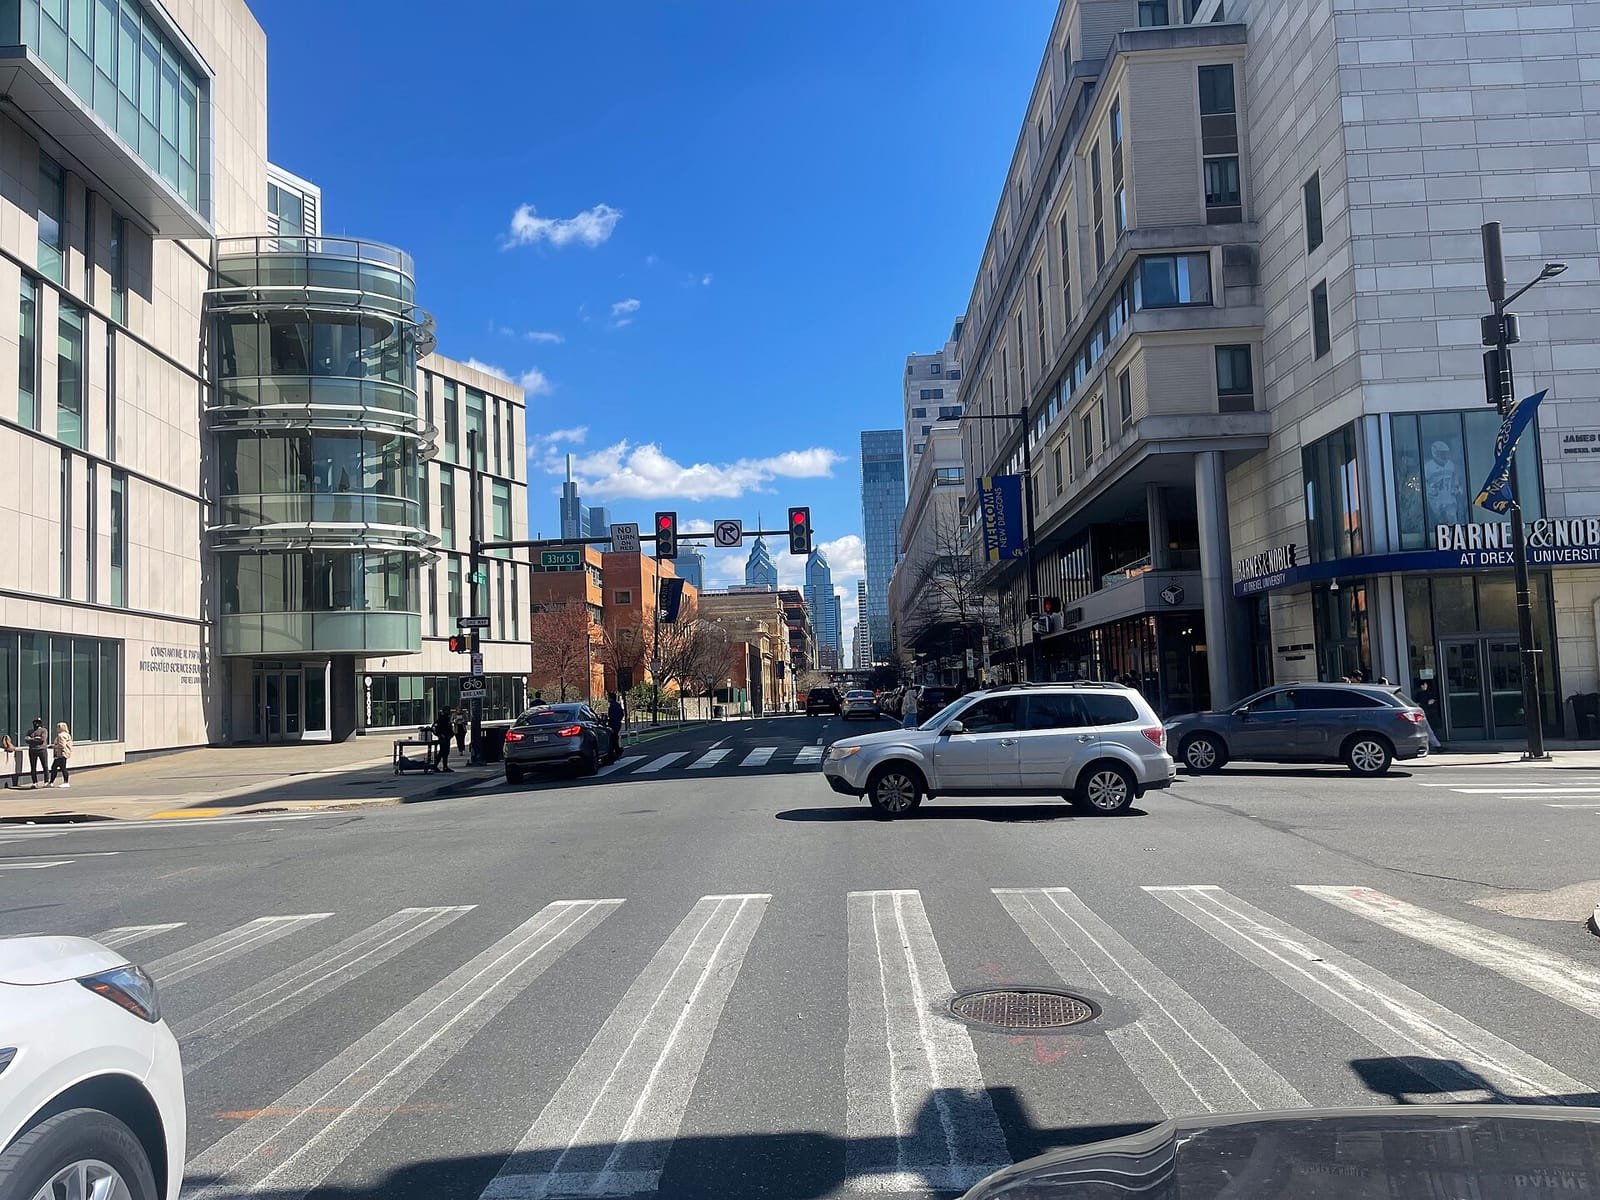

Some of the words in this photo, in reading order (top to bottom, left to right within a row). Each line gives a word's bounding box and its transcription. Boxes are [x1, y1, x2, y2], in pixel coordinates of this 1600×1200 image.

[1563, 434, 1596, 443] JAMES
[983, 488, 999, 551] WELCOME
[617, 526, 632, 534] NO
[1000, 529, 1008, 548] NEW
[1529, 518, 1554, 548] &
[547, 554, 565, 564] 33rd
[566, 554, 574, 563] St
[1238, 554, 1262, 582] BARNES
[1268, 545, 1292, 574] NOBLE
[1460, 553, 1475, 565] AT
[1481, 551, 1530, 565] DREX
[1534, 548, 1600, 562] UNIVERSIT
